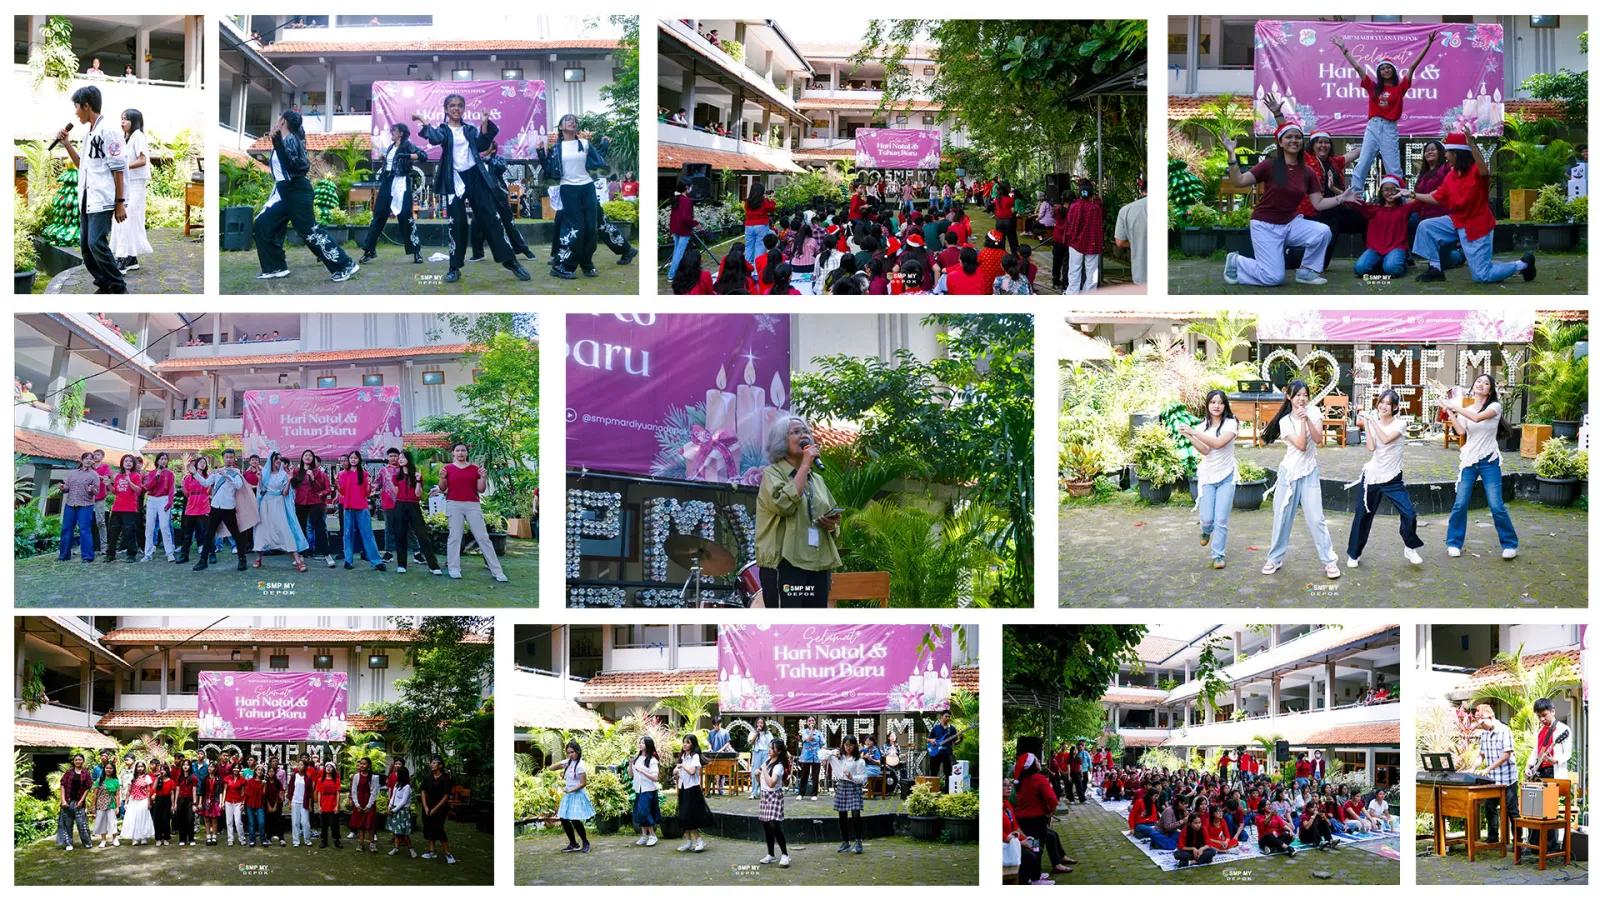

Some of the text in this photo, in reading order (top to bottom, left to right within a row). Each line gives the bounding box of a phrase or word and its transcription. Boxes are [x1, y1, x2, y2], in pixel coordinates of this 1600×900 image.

[1440, 31, 1462, 48] 76
[1420, 64, 1441, 80] &
[1321, 82, 1438, 99] Tahu aru
[566, 338, 650, 377] aru
[1354, 349, 1525, 387] SMP MY
[280, 413, 306, 424] Hari
[308, 413, 341, 424] Natal
[282, 425, 357, 436] Tahun Baru
[803, 626, 858, 646] Selamat
[774, 642, 887, 661] Hari Natal &
[776, 662, 885, 679] Tahun Baru
[235, 696, 260, 707] Hari
[262, 696, 294, 708] Natal
[236, 707, 307, 719] Tahun Baru
[250, 743, 341, 767] SMP MY
